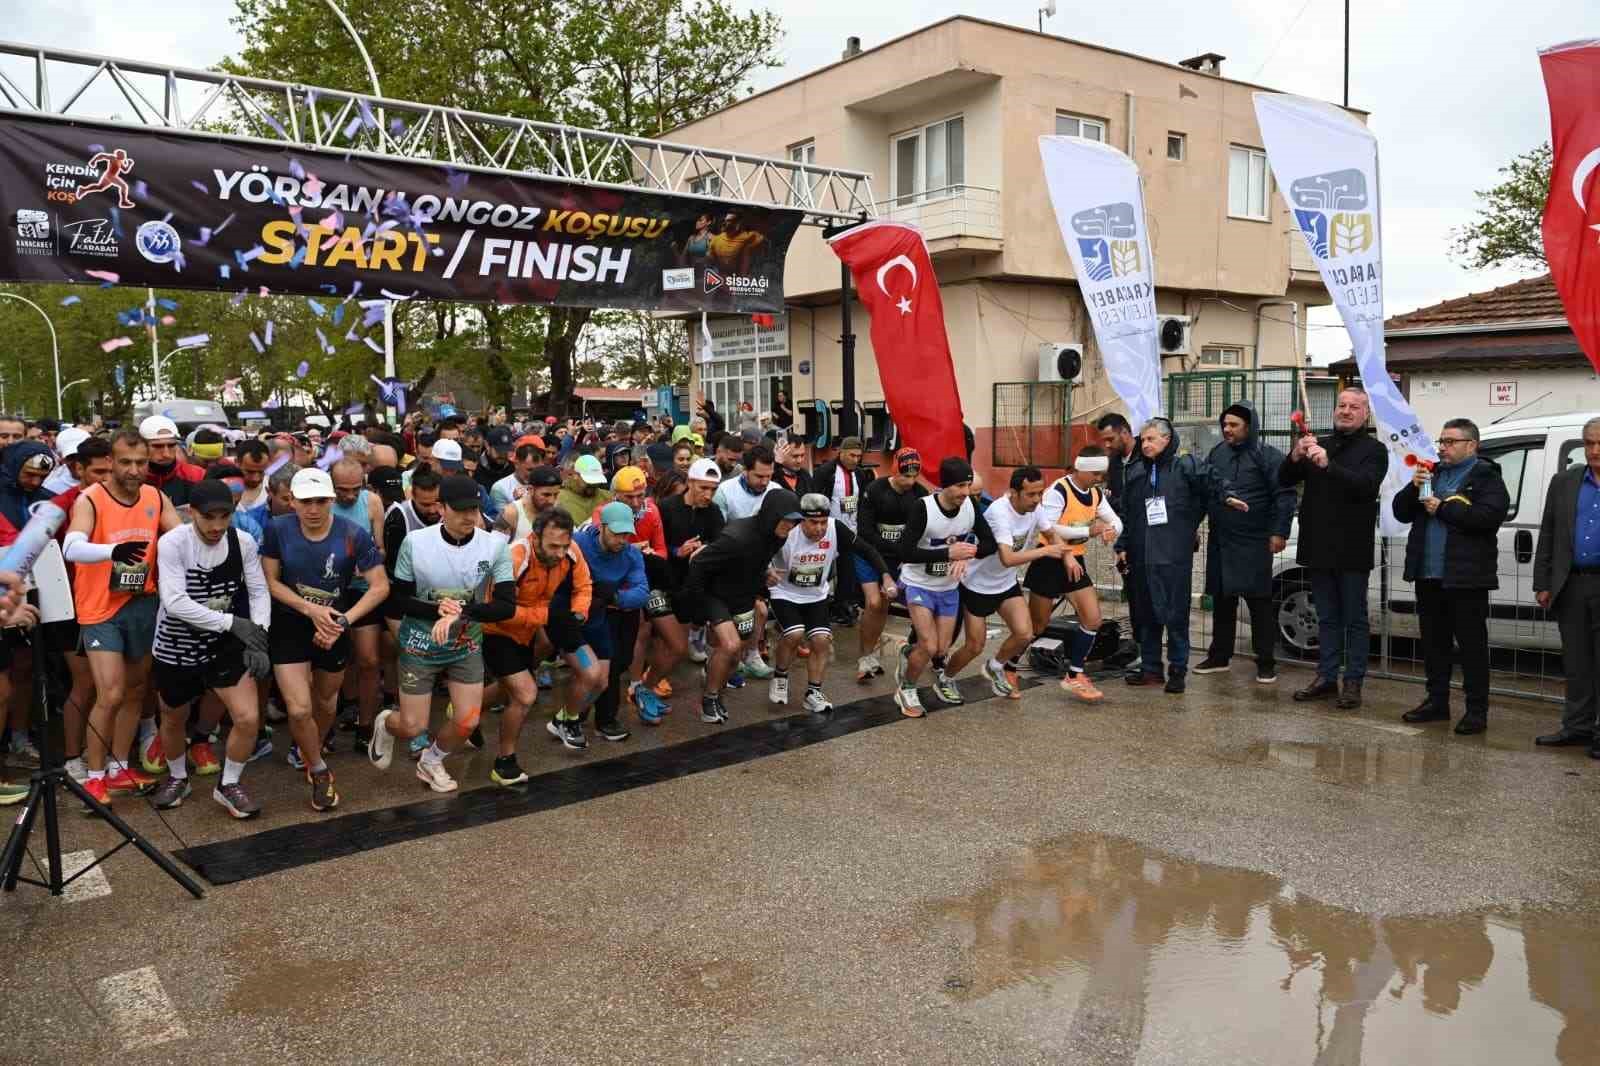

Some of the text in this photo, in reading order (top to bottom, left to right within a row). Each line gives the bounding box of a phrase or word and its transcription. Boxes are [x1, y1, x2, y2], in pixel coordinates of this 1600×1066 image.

[46, 163, 99, 177] KENDİN
[46, 174, 76, 189] İÇİN
[47, 191, 76, 204] KOŞ
[543, 208, 672, 240] KOŞUSU
[256, 220, 440, 272] START
[478, 237, 631, 284] FINISH
[726, 273, 769, 289] SİSDAĞI
[122, 573, 145, 584] 1080
